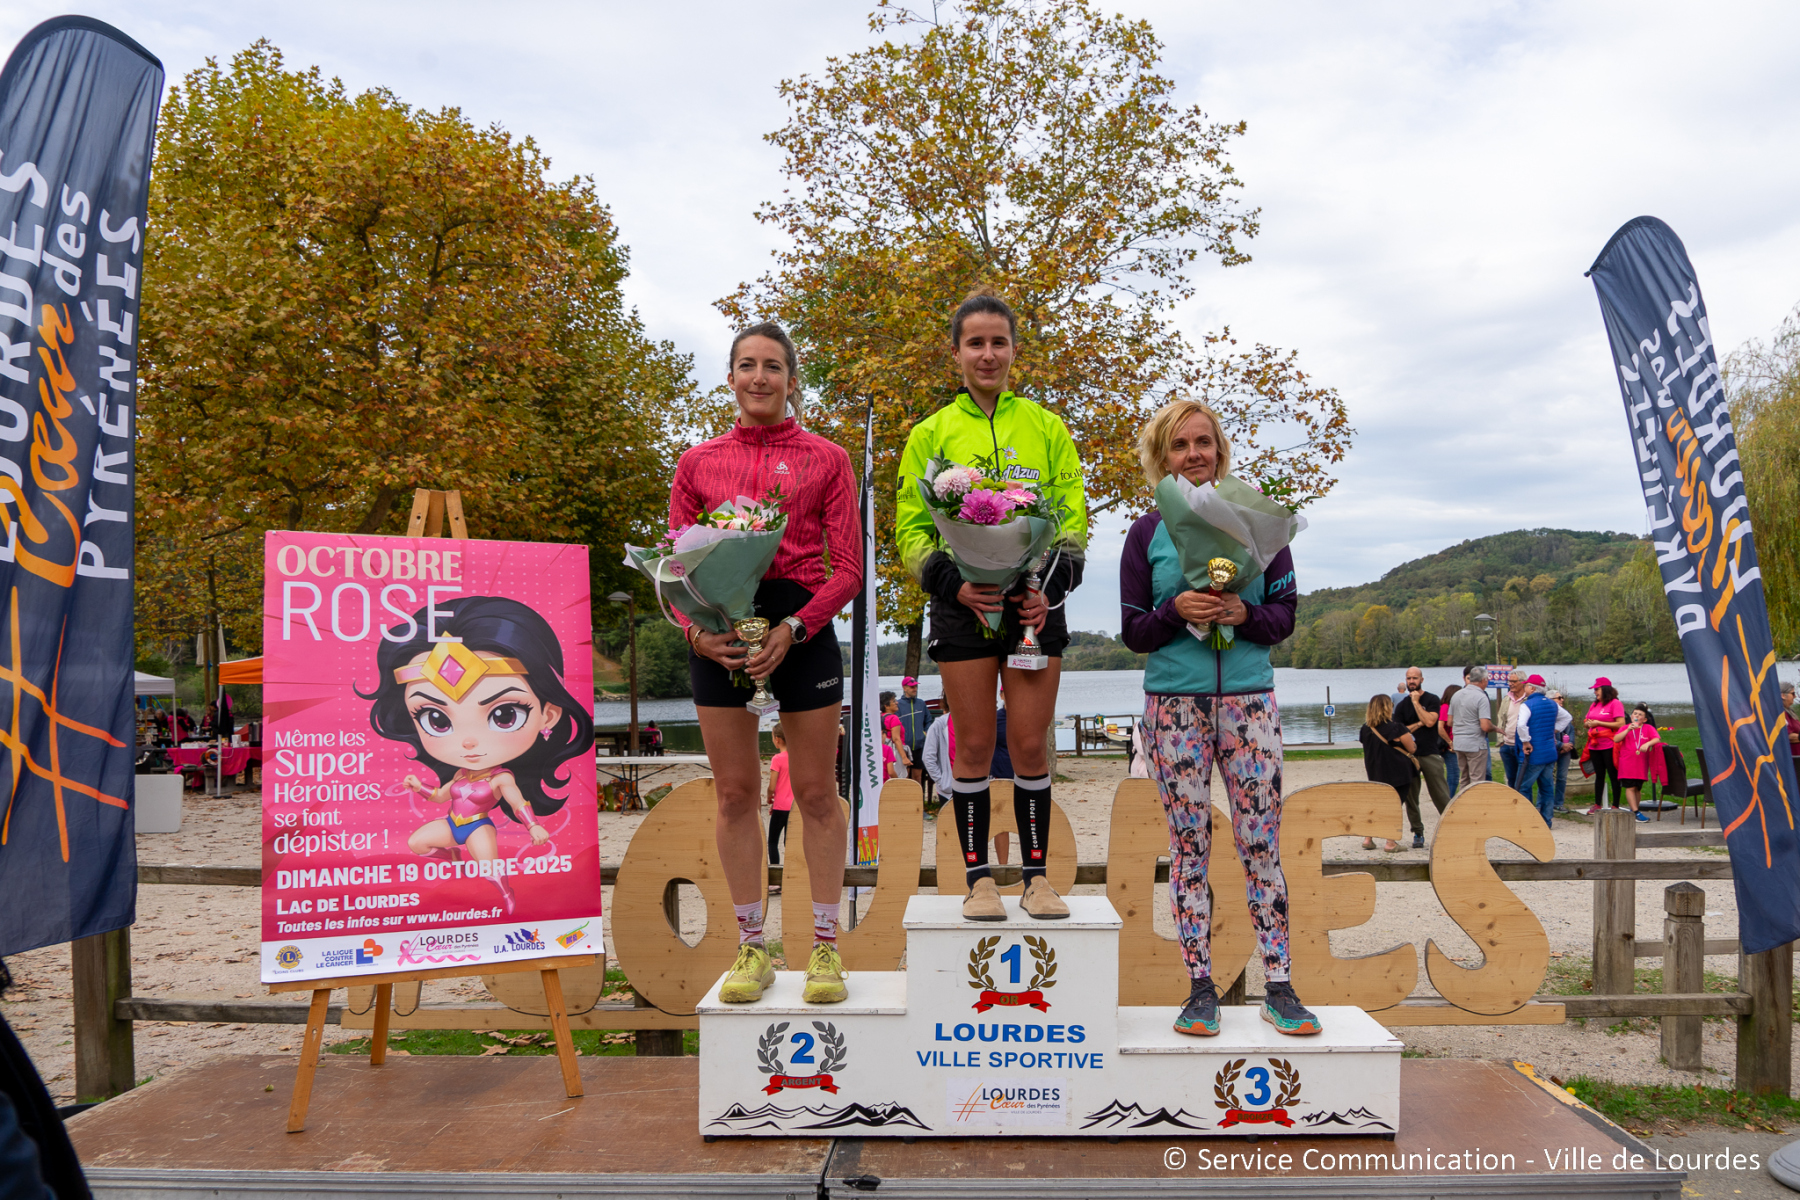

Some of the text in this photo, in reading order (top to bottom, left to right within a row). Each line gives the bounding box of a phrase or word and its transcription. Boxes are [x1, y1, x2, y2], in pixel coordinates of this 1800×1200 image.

[42, 183, 91, 297] des
[276, 544, 463, 582] OCTOBRE
[282, 580, 464, 644] ROSE
[274, 729, 366, 748] Même les
[274, 749, 374, 783] Super
[273, 780, 382, 804] Héroïnes
[273, 808, 342, 828] se font
[1030, 798, 1039, 849] COMPRESSPORT
[273, 828, 390, 858] dépister !
[276, 854, 573, 891] DIMANCHE 19 OCTOBRE 2025
[276, 892, 420, 916] LAC DE LOURDES
[276, 906, 503, 934] Toutes les infos sur www.lourdes.fr
[420, 932, 479, 946] LOURDES
[493, 941, 546, 954] U.A. LOURDES
[324, 955, 354, 963] CONTRE
[332, 948, 354, 956] LIGUE
[325, 960, 354, 968] CANCER
[1000, 944, 1021, 984] 1
[1000, 995, 1019, 1006] OR
[935, 1022, 1086, 1044] LOURDES
[790, 1032, 815, 1065] 2
[916, 1050, 1104, 1070] VILLE SPORTIVE
[780, 1077, 823, 1087] ARGENT
[1244, 1066, 1272, 1106] 3
[982, 1088, 1061, 1101] LOURDES
[990, 1093, 1025, 1110] Cœur
[1036, 1102, 1061, 1110] Pyrénées
[1237, 1113, 1274, 1121] BRONZE
